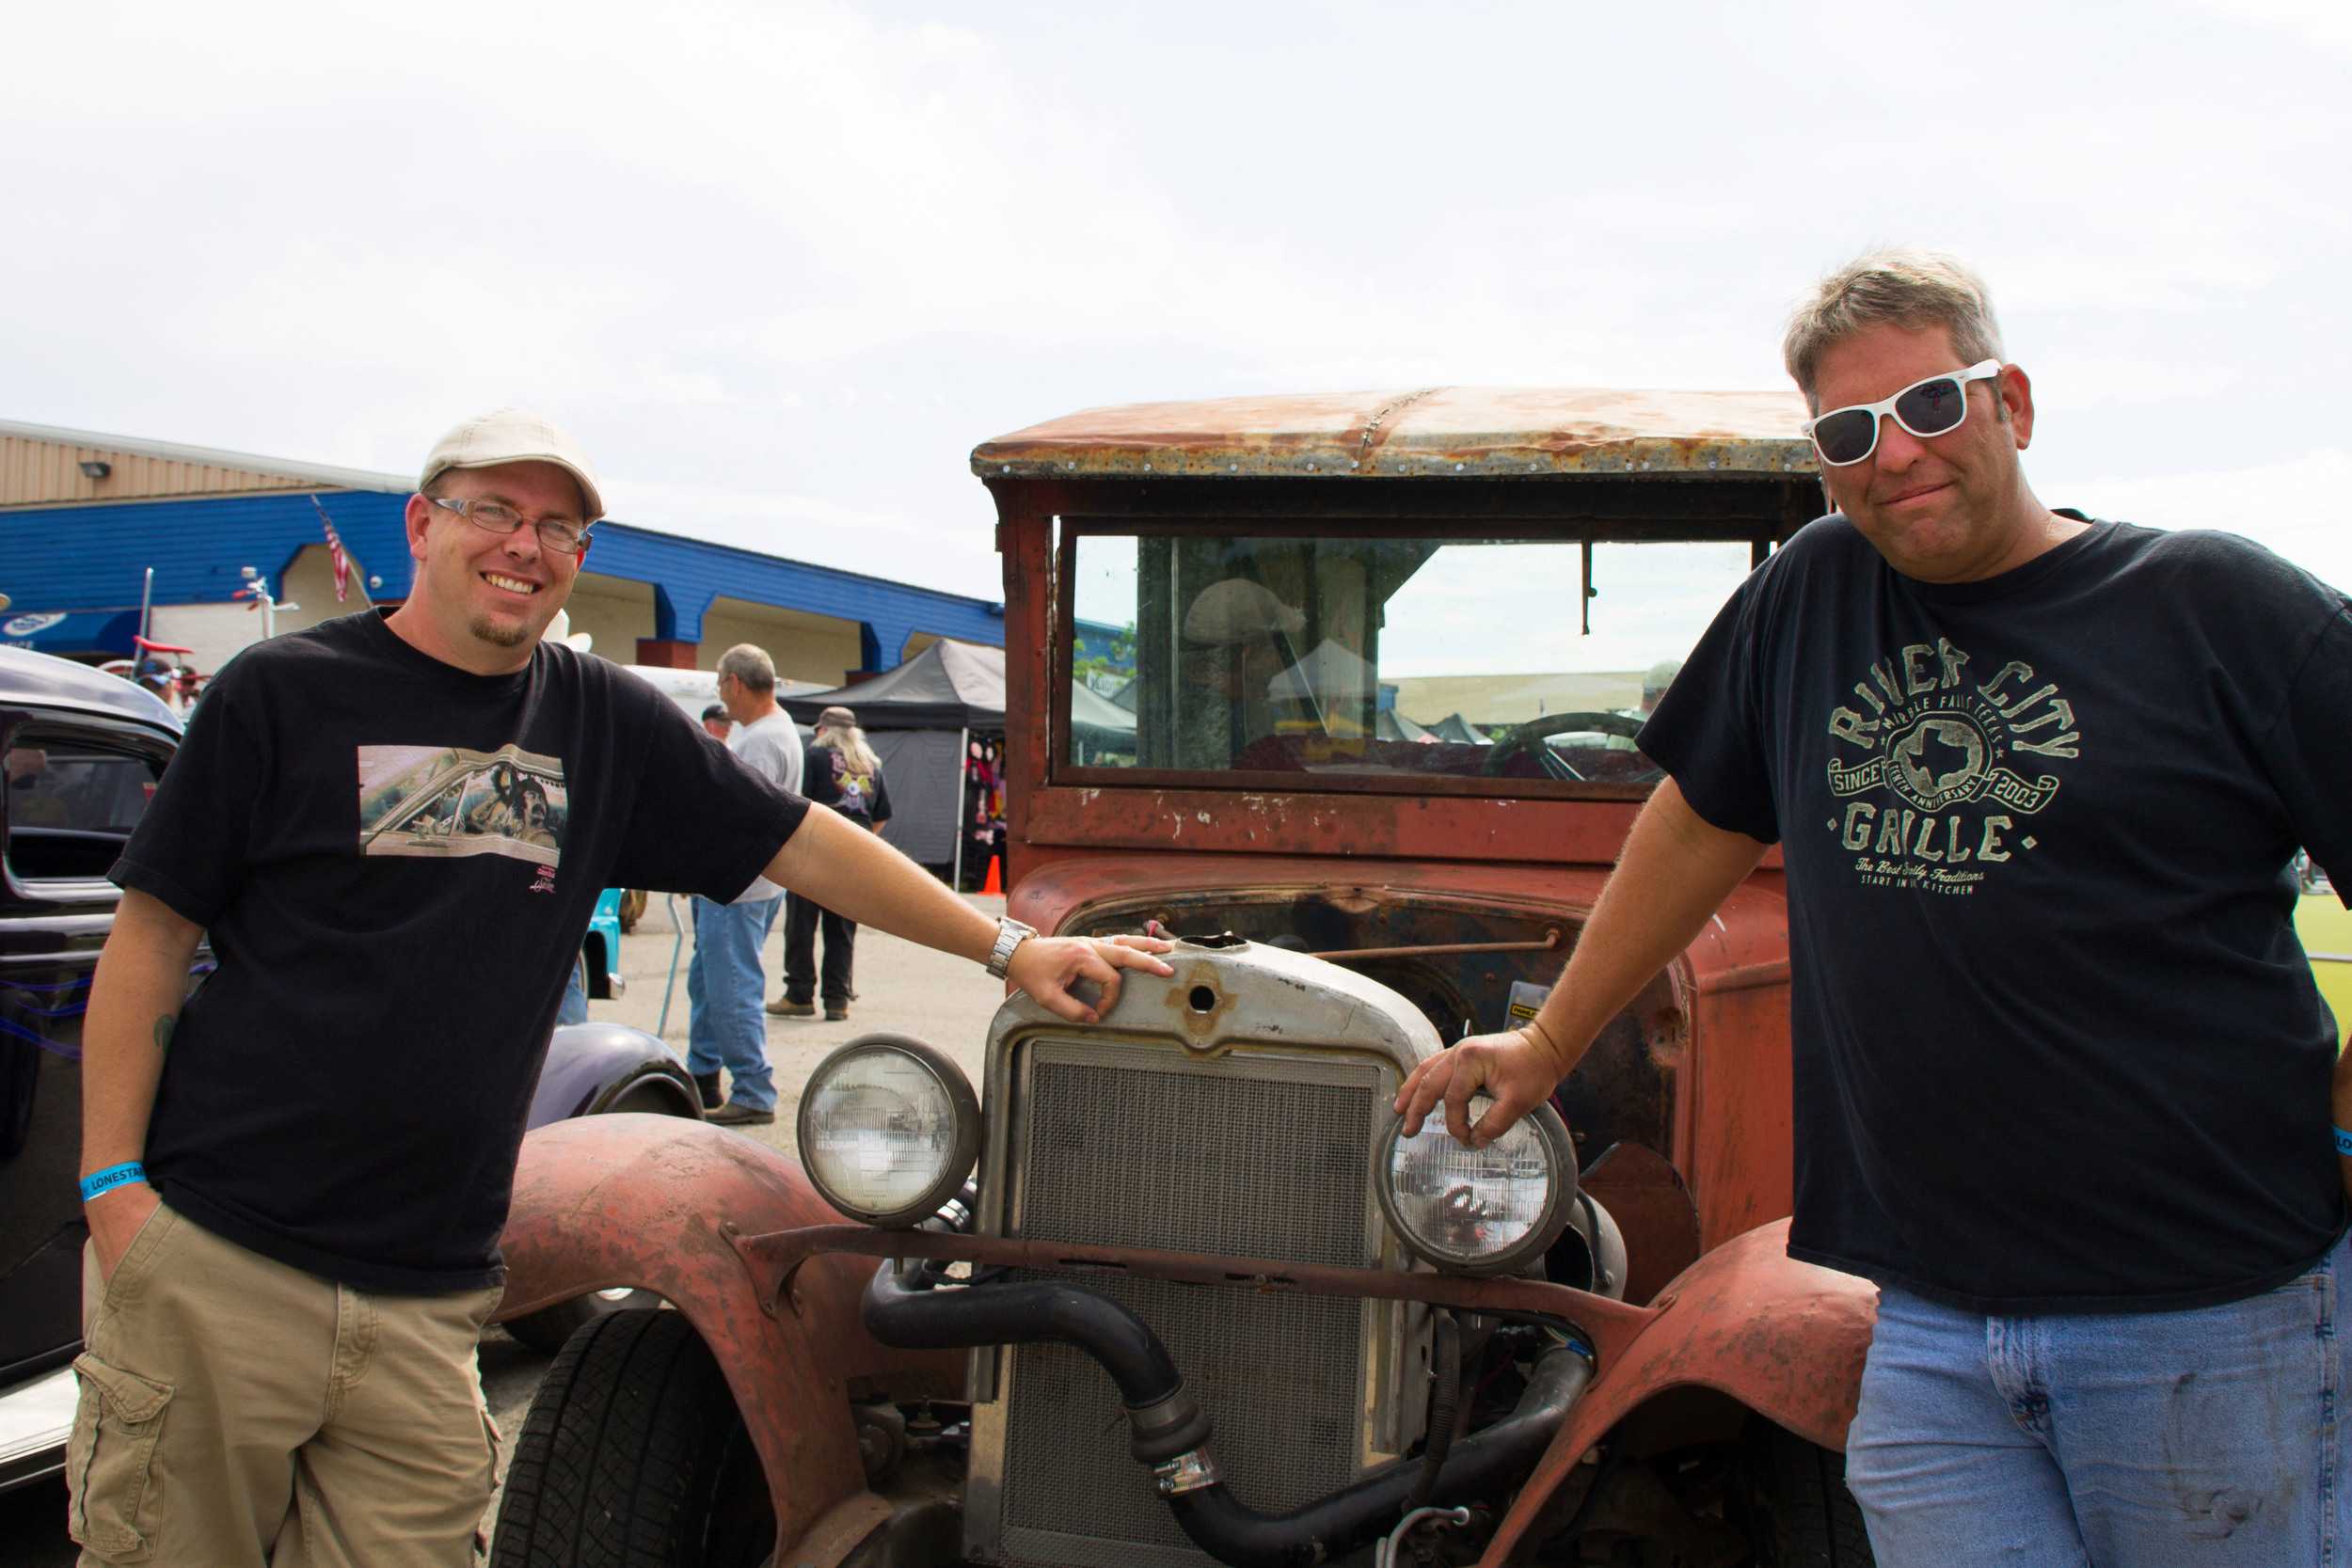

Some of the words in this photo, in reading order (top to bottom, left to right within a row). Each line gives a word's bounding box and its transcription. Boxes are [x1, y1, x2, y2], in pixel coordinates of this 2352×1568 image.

[1828, 637, 1970, 750] RIVER
[1977, 660, 2080, 758] CITY
[1834, 765, 1882, 792] SINCE
[1995, 776, 2042, 808] 2003
[1841, 801, 2013, 863] GRILLE
[1855, 857, 1874, 872] The
